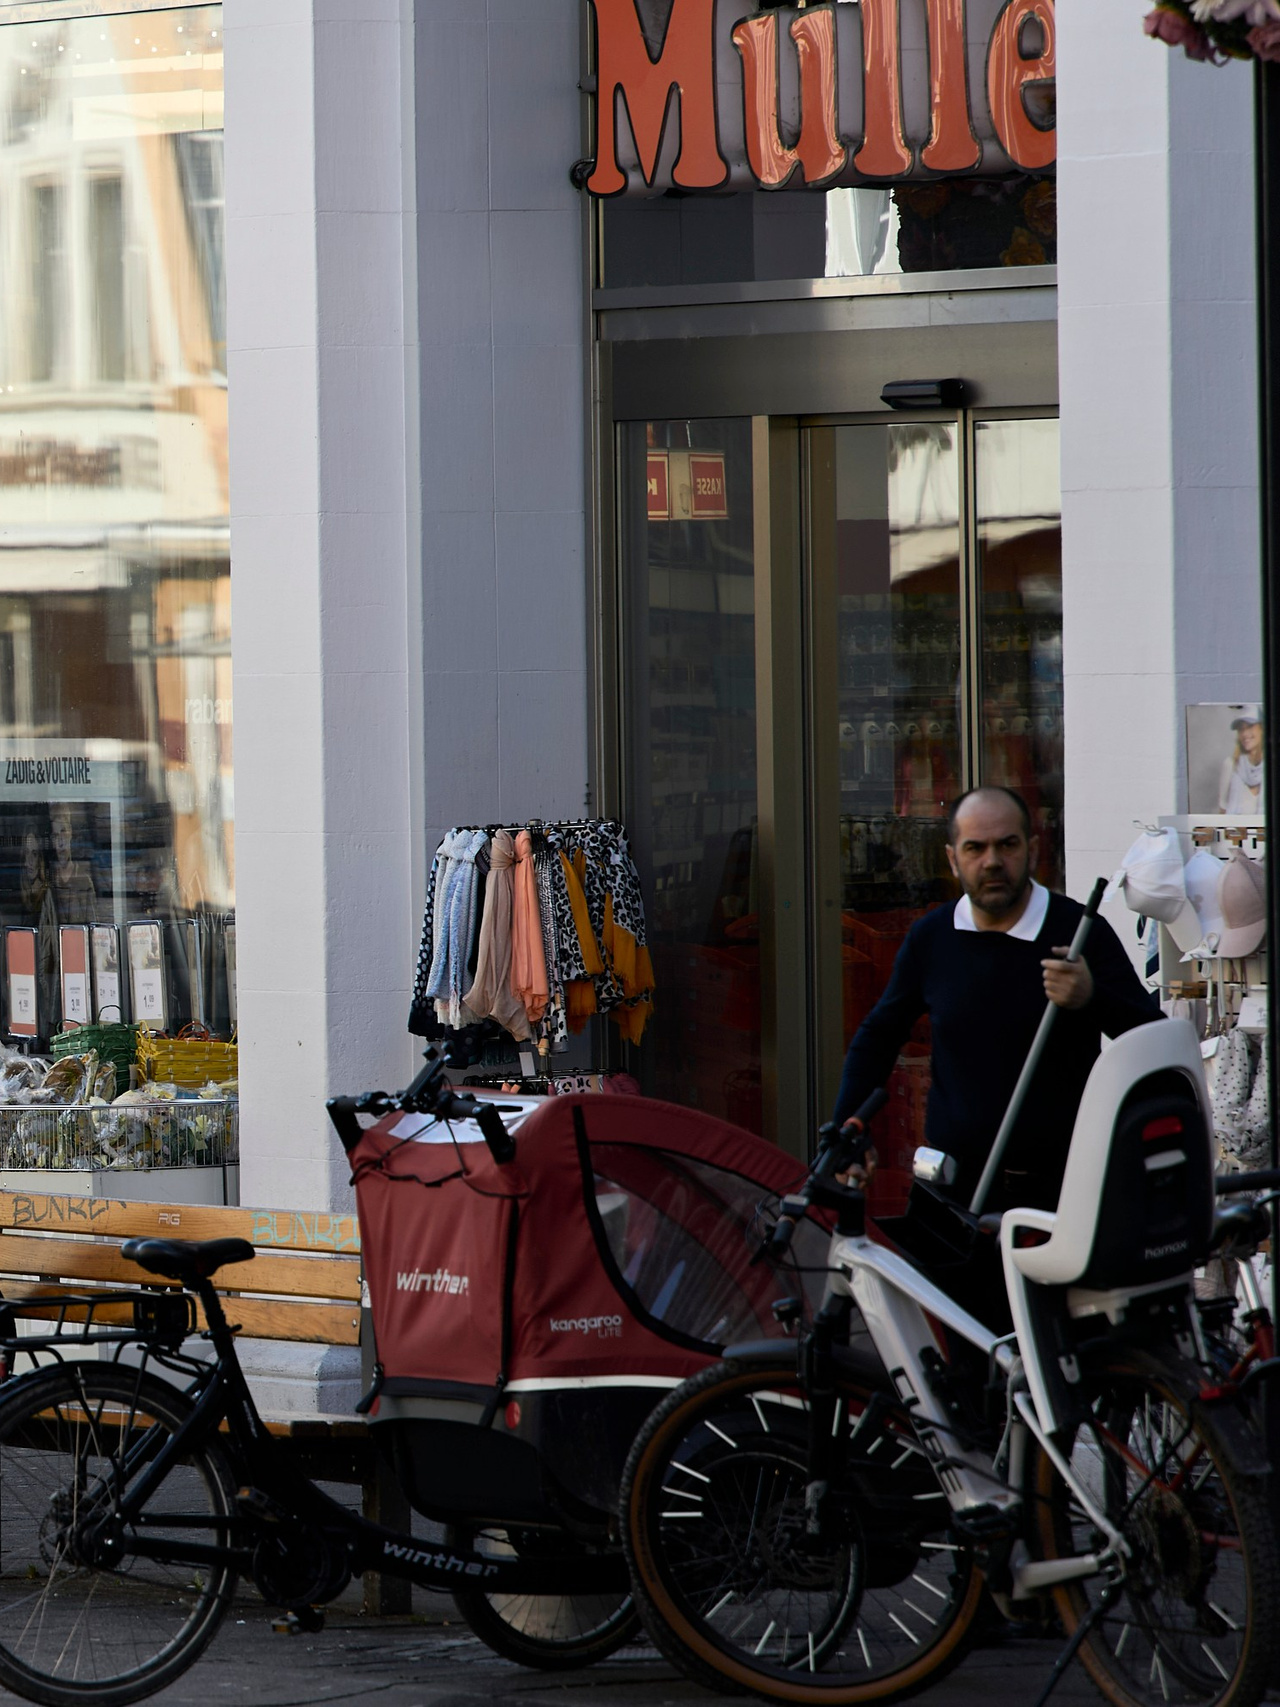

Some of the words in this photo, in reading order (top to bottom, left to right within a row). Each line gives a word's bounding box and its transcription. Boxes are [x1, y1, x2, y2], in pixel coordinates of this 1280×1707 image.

[5, 756, 92, 785] ZADIG&VOLTAIRE
[396, 1267, 469, 1296] winther
[549, 1314, 623, 1335] kangaroo
[597, 1326, 623, 1339] LITE
[383, 1541, 499, 1577] winther
